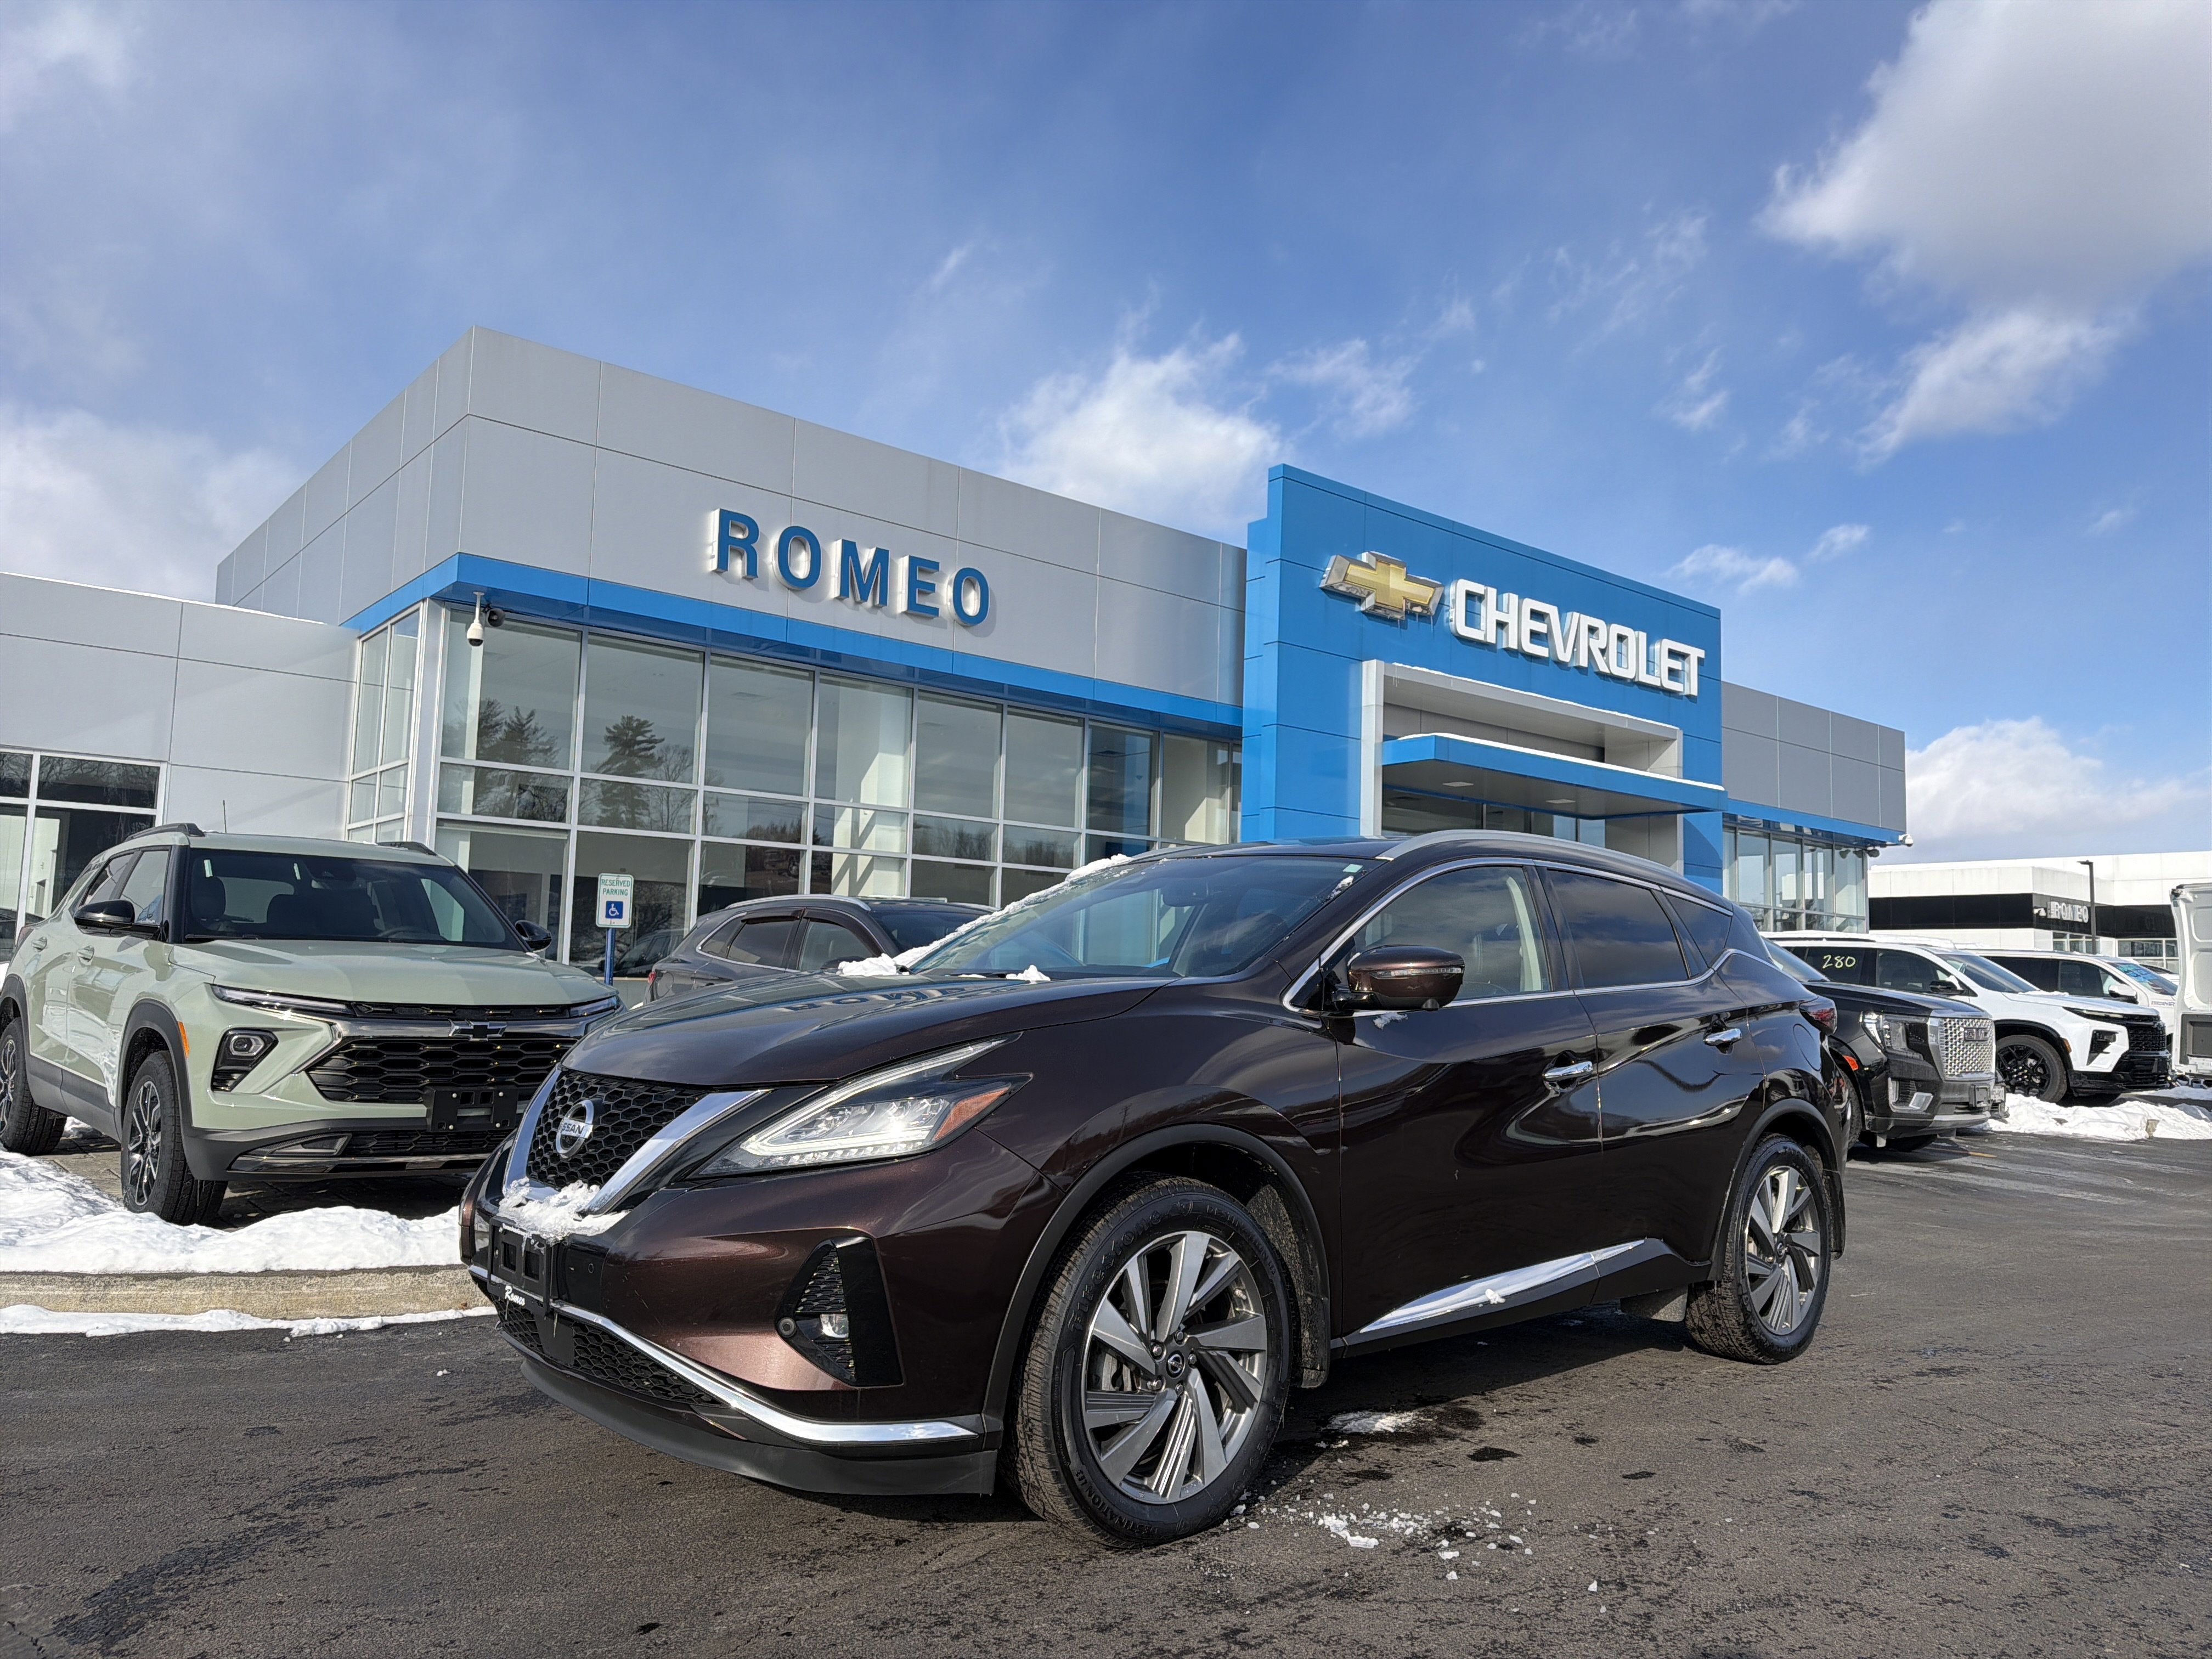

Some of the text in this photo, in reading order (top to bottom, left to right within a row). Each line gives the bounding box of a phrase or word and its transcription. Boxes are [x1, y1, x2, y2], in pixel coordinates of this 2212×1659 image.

[714, 508, 989, 626] ROMEO
[1450, 579, 1705, 696] CHEVROLET
[601, 879, 630, 887] RESERVED
[1822, 955, 1856, 969] 280
[560, 1122, 585, 1135] SSAN
